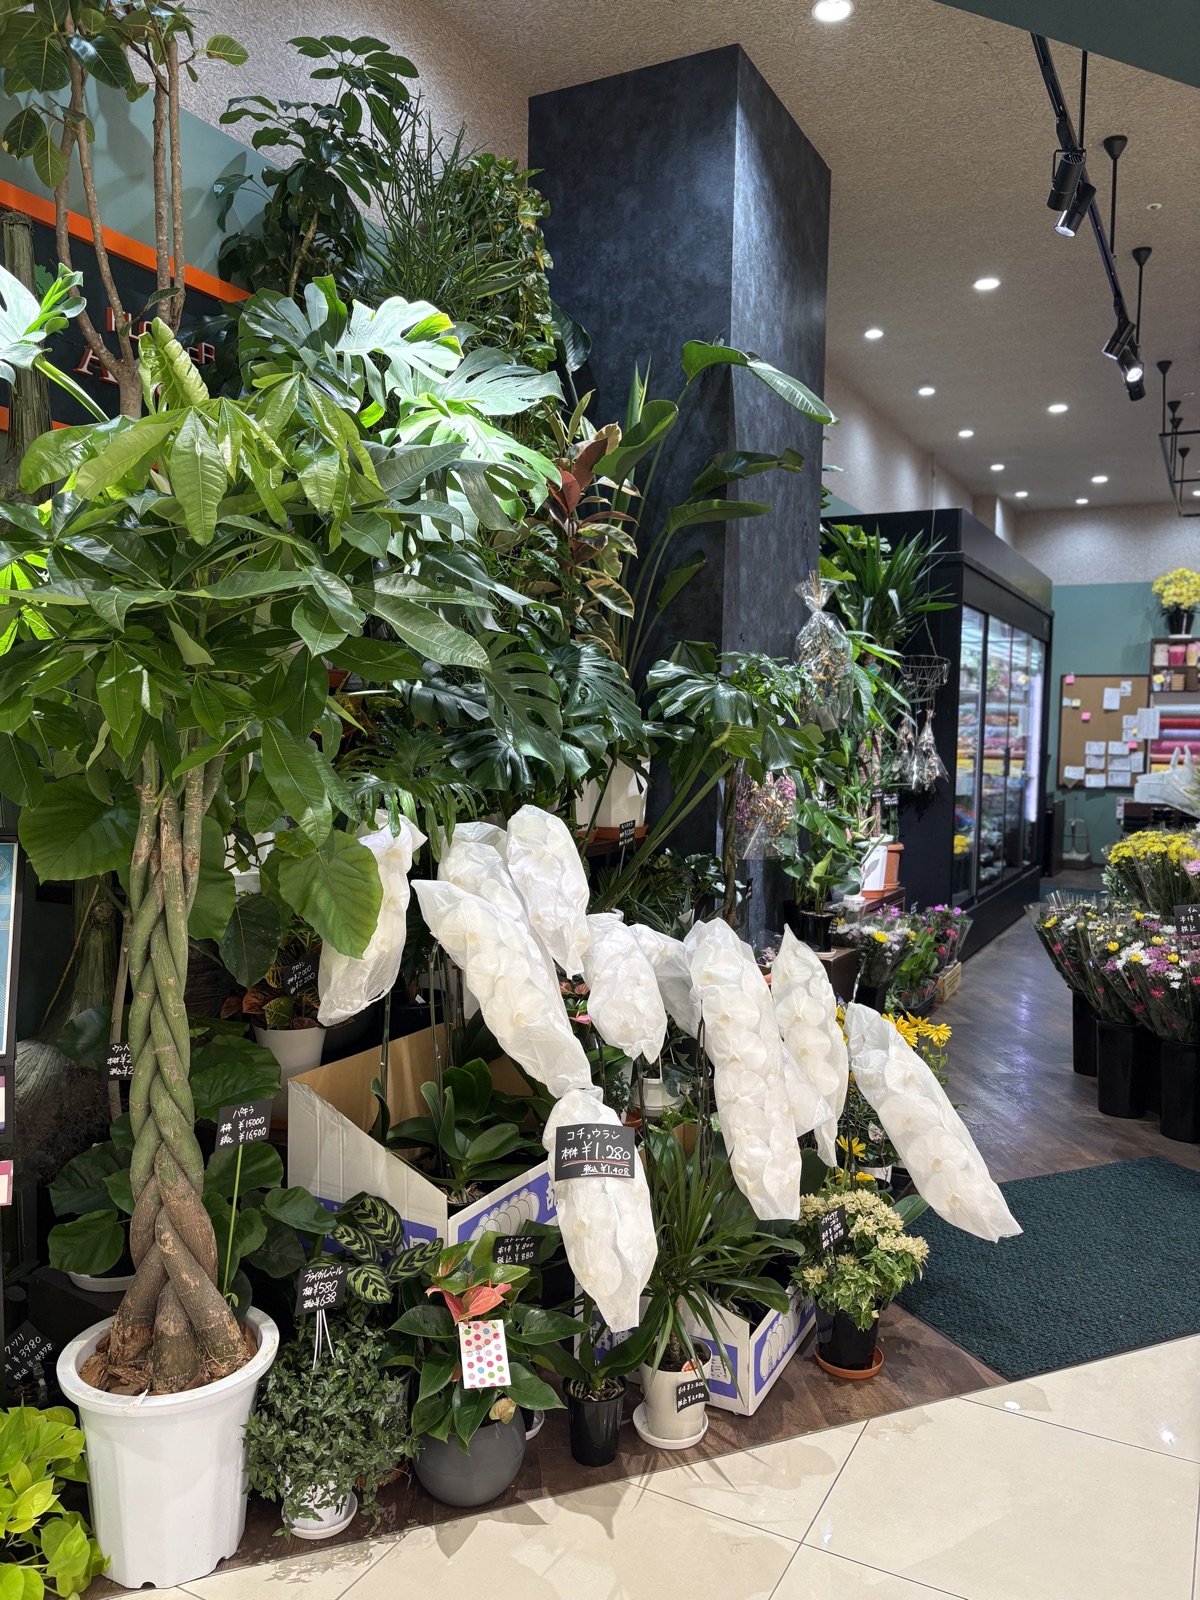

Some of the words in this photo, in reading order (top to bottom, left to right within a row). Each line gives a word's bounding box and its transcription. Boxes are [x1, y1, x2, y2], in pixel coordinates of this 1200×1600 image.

[566, 1127, 621, 1141] コチョウラン
[313, 1279, 339, 1296] ¥580
[314, 1291, 337, 1308] ¥638
